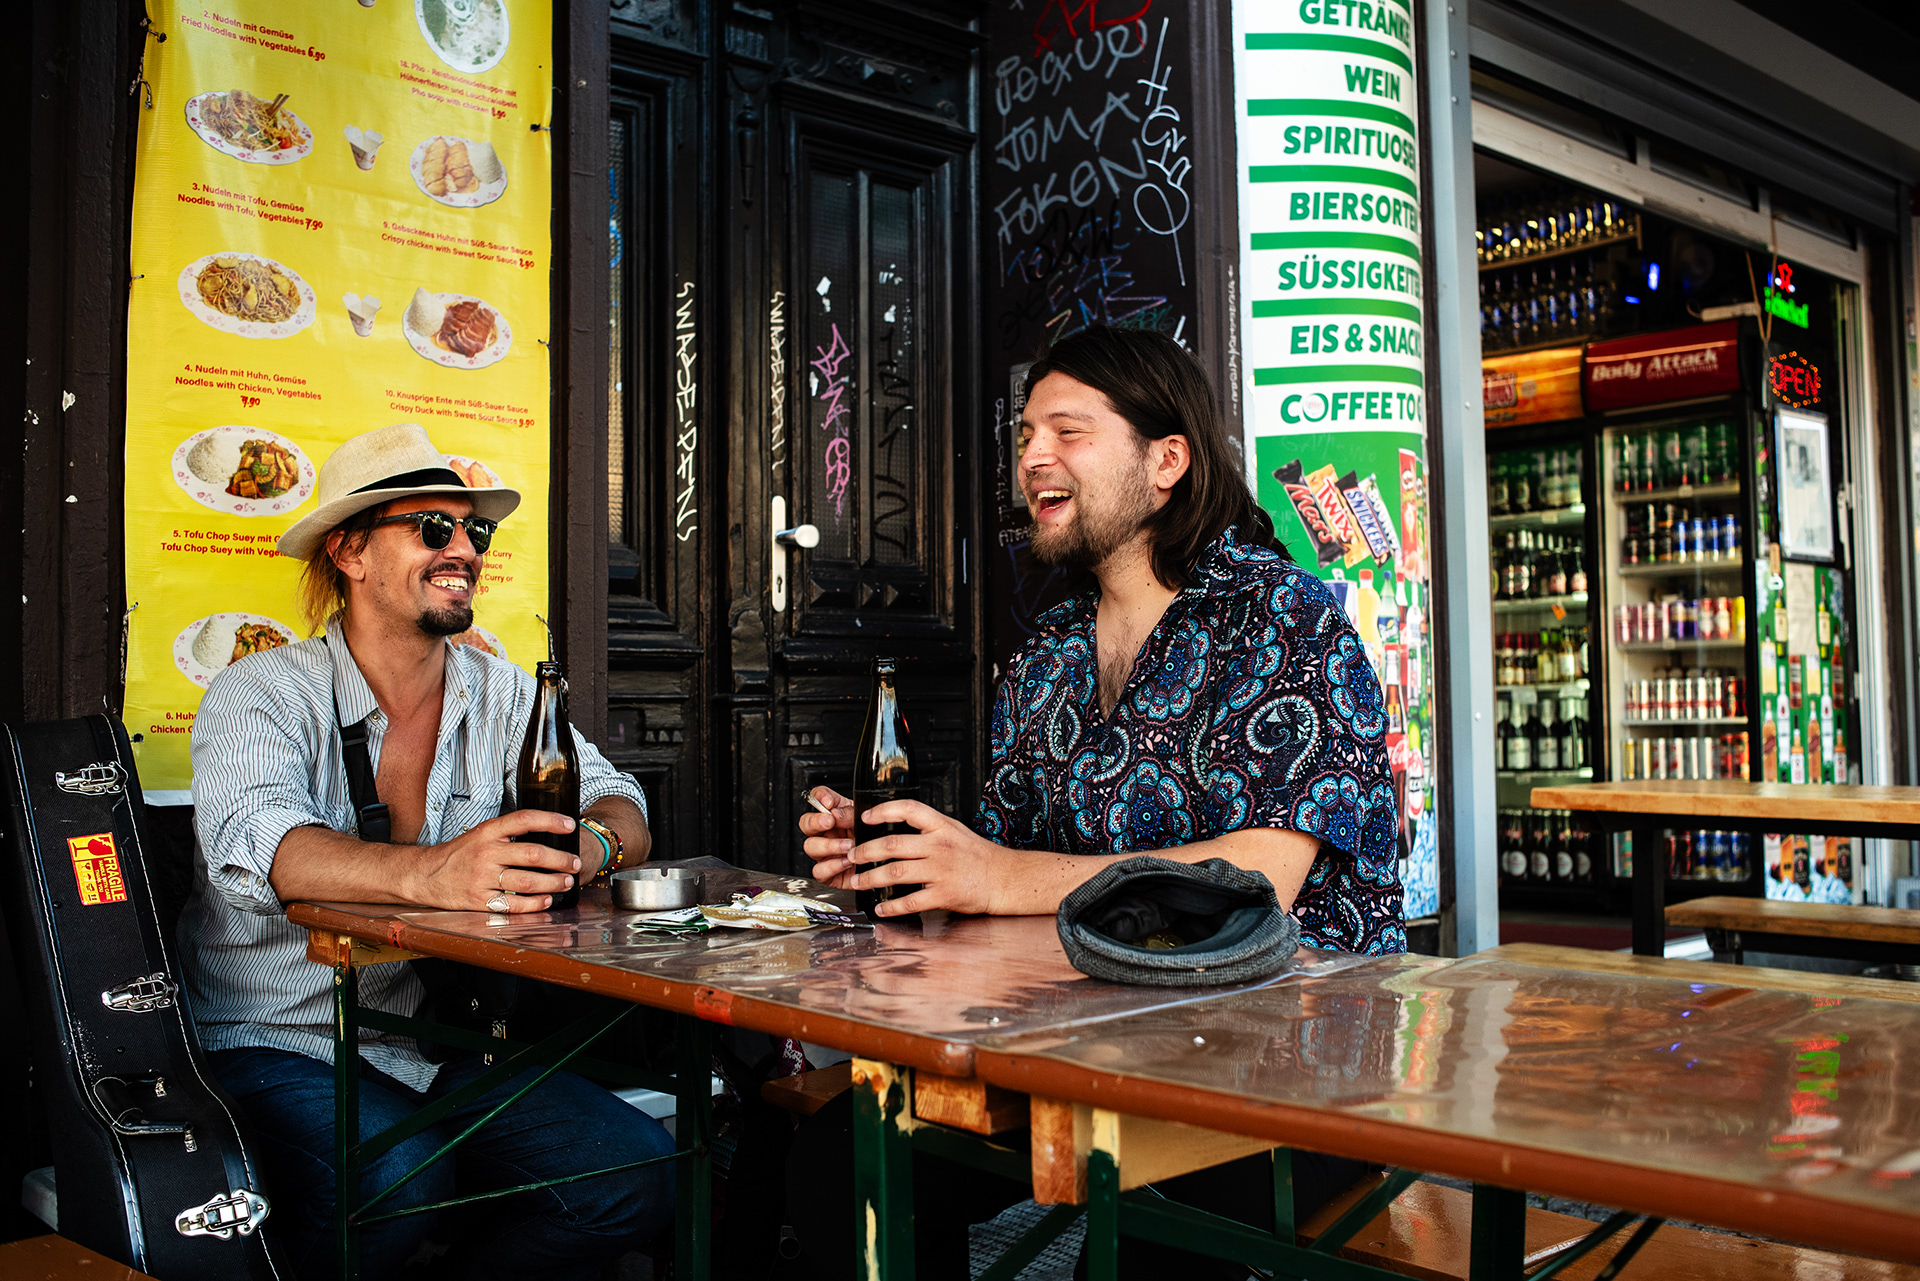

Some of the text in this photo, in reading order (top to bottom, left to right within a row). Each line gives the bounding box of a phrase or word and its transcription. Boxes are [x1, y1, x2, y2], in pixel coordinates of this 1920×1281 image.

[182, 16, 325, 61] Fried Noodles with Vegetables 6.90
[204, 10, 294, 40] 2. Nudeln mit Gemüse
[400, 72, 449, 91] Hühnerfleisch
[451, 87, 464, 95] und
[1344, 64, 1400, 102] WEIN
[412, 87, 426, 97] Pho
[428, 92, 444, 103] soup
[446, 98, 461, 106] with
[463, 102, 489, 113] chicken
[1283, 126, 1416, 173] SPIRITUOSE
[178, 194, 323, 230] Noodles with Tofu, Vegetables 7.90
[192, 182, 305, 213] 3. Nudeln mit Tofu, Gemüse
[1290, 192, 1418, 235] BIERSORTE
[382, 233, 405, 246] Crispy
[407, 239, 434, 250] chicken
[436, 245, 451, 254] with
[453, 248, 475, 258] Sweet
[477, 252, 494, 261] Sour
[496, 255, 518, 265] Sauce
[383, 221, 533, 256] 9. Gebackenes Huhn mit Süß-Sauer Sauce
[1290, 324, 1339, 354] EIS
[1345, 323, 1363, 353] &
[185, 364, 306, 385] 4. Nudeln mit Huhn, Gemüse
[1592, 348, 1718, 382] Body Attack
[1771, 361, 1818, 398] OPEN
[175, 376, 322, 400] Noodles with Chicken, Vegetables
[386, 389, 528, 414] 10. Knusprige Ente mit Süß-Sauer Sauce
[390, 402, 413, 414] Crispy
[415, 405, 434, 414] Duck
[436, 408, 452, 416] with
[454, 410, 476, 419] Sweet
[478, 413, 495, 421] Sour
[496, 416, 517, 424] Sauce
[1280, 392, 1392, 424] COFFEE
[1397, 392, 1416, 421] TO
[1284, 484, 1338, 544] Mars
[1347, 490, 1389, 554] SNICKERS
[161, 542, 181, 551] Tofu
[184, 544, 208, 554] Chop
[210, 545, 232, 556] Suey
[235, 547, 255, 555] with
[173, 530, 181, 538] 5.
[184, 530, 204, 539] Tofu
[206, 531, 230, 542] Chop
[232, 533, 255, 543] Suey
[257, 534, 272, 542] mit
[492, 550, 512, 560] Curry
[485, 574, 504, 583] Curry
[150, 725, 185, 734] Chicken
[166, 712, 173, 720] 6.
[104, 857, 125, 901] FRAGILE
